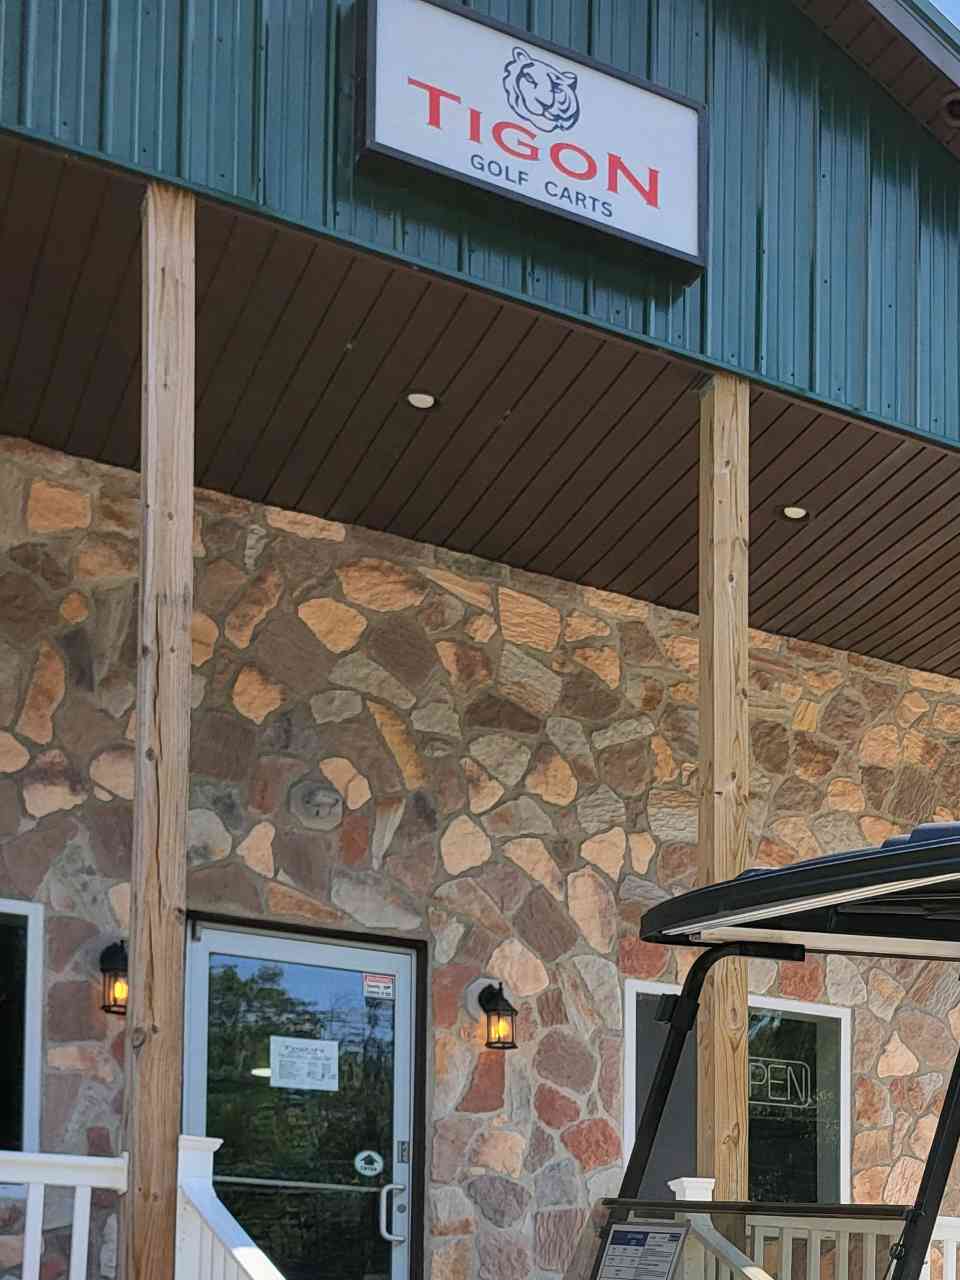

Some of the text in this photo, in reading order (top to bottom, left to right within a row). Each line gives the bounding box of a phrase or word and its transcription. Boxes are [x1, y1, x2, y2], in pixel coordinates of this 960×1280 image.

[407, 76, 661, 209] TIGON
[470, 153, 614, 219] GOLF CARTS
[749, 1063, 806, 1102] PEN
